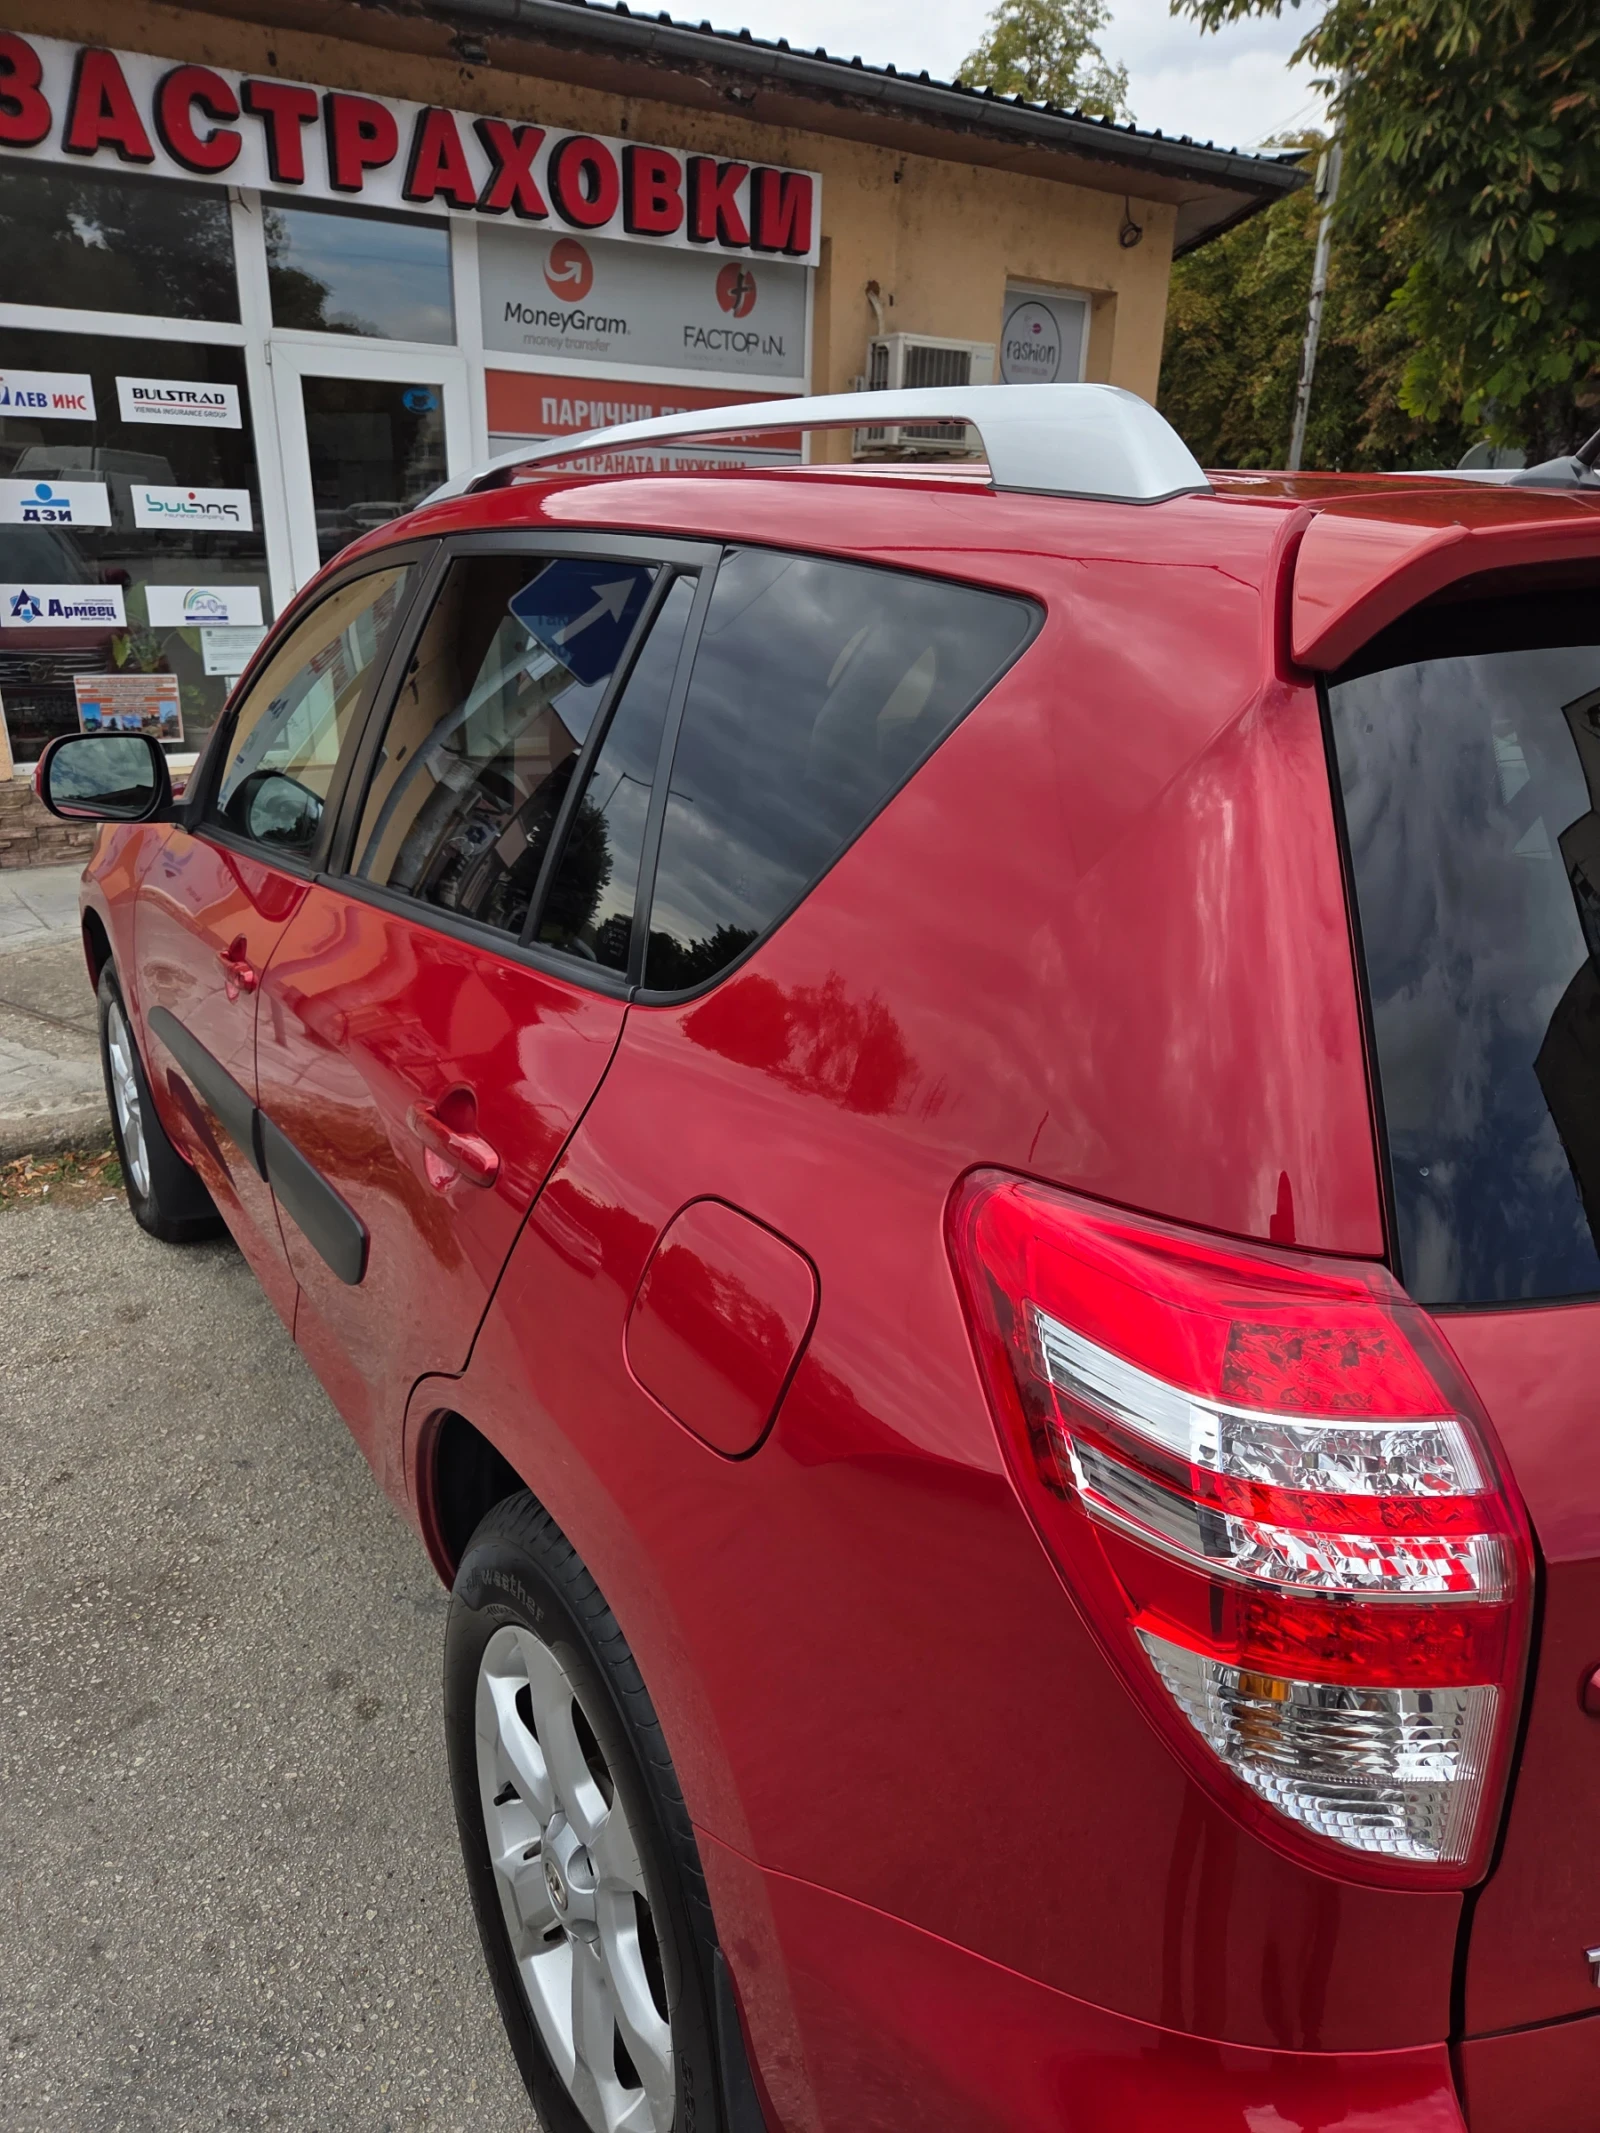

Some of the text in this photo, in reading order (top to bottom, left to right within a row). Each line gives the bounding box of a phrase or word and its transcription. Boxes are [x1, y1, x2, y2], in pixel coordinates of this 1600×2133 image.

[0, 31, 813, 256] ЗАСТРАХОВКИ
[504, 302, 628, 334] MoneyGram
[523, 334, 611, 352] money transfer
[15, 391, 87, 411] ЛЕВ ИНС
[132, 388, 225, 405] BULSTRAD
[134, 406, 227, 419] VIENNA INSURANCE GROUP
[541, 397, 652, 427] ПАРИЧНИ
[23, 509, 73, 522] ДЗИ
[48, 599, 117, 620] Армеец
